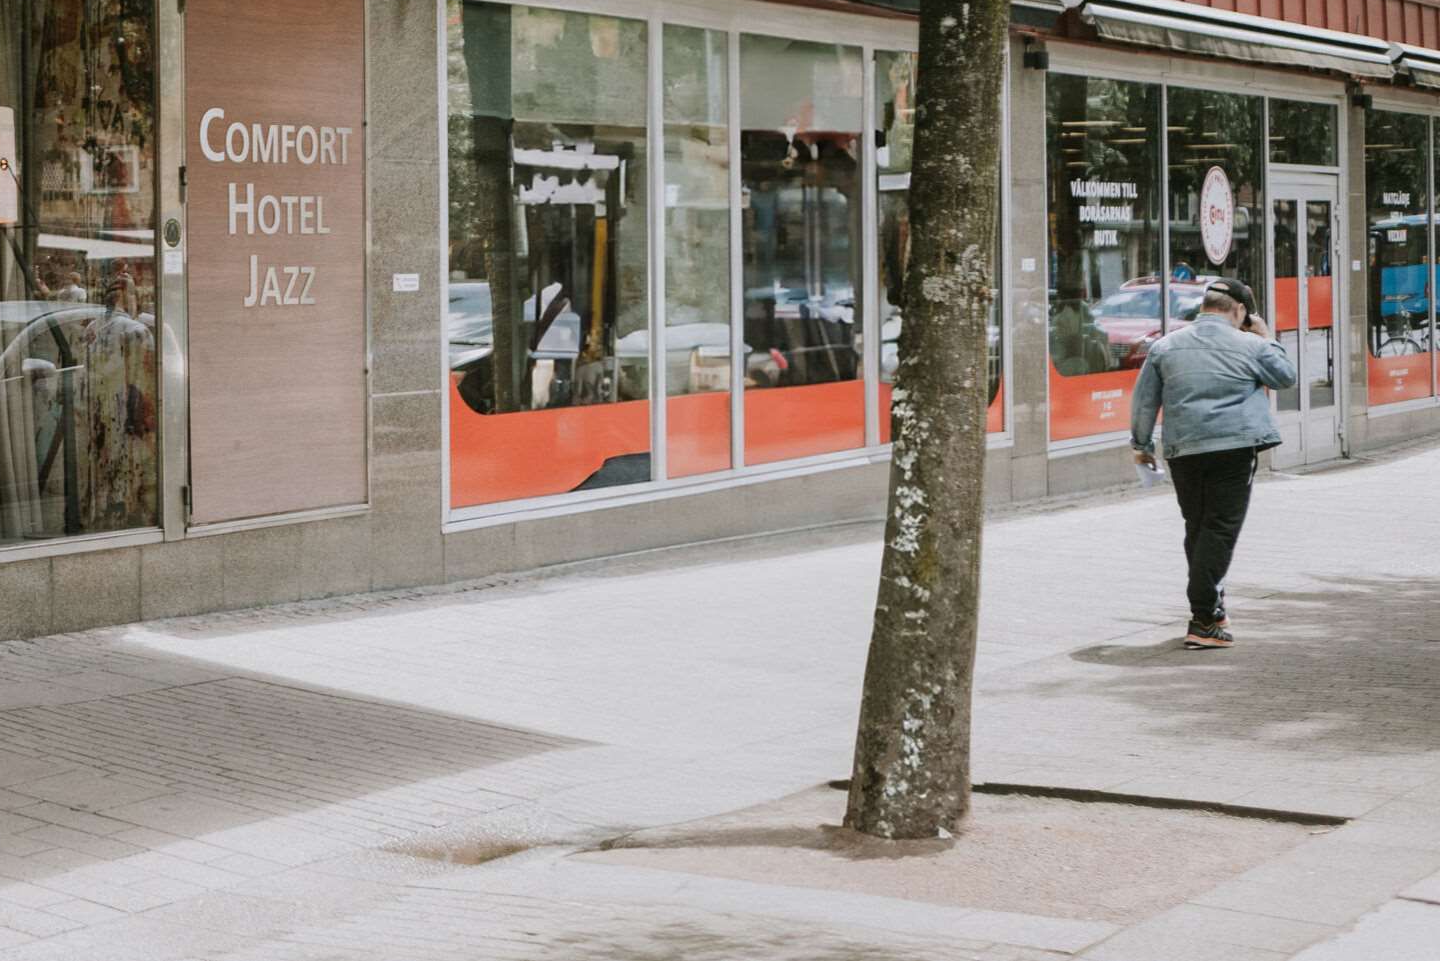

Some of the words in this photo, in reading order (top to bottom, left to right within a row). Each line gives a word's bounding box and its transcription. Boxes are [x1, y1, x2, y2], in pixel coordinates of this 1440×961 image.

[199, 106, 353, 165] COMFORT
[228, 182, 332, 235] HOTEL
[244, 254, 317, 308] JAZZ
